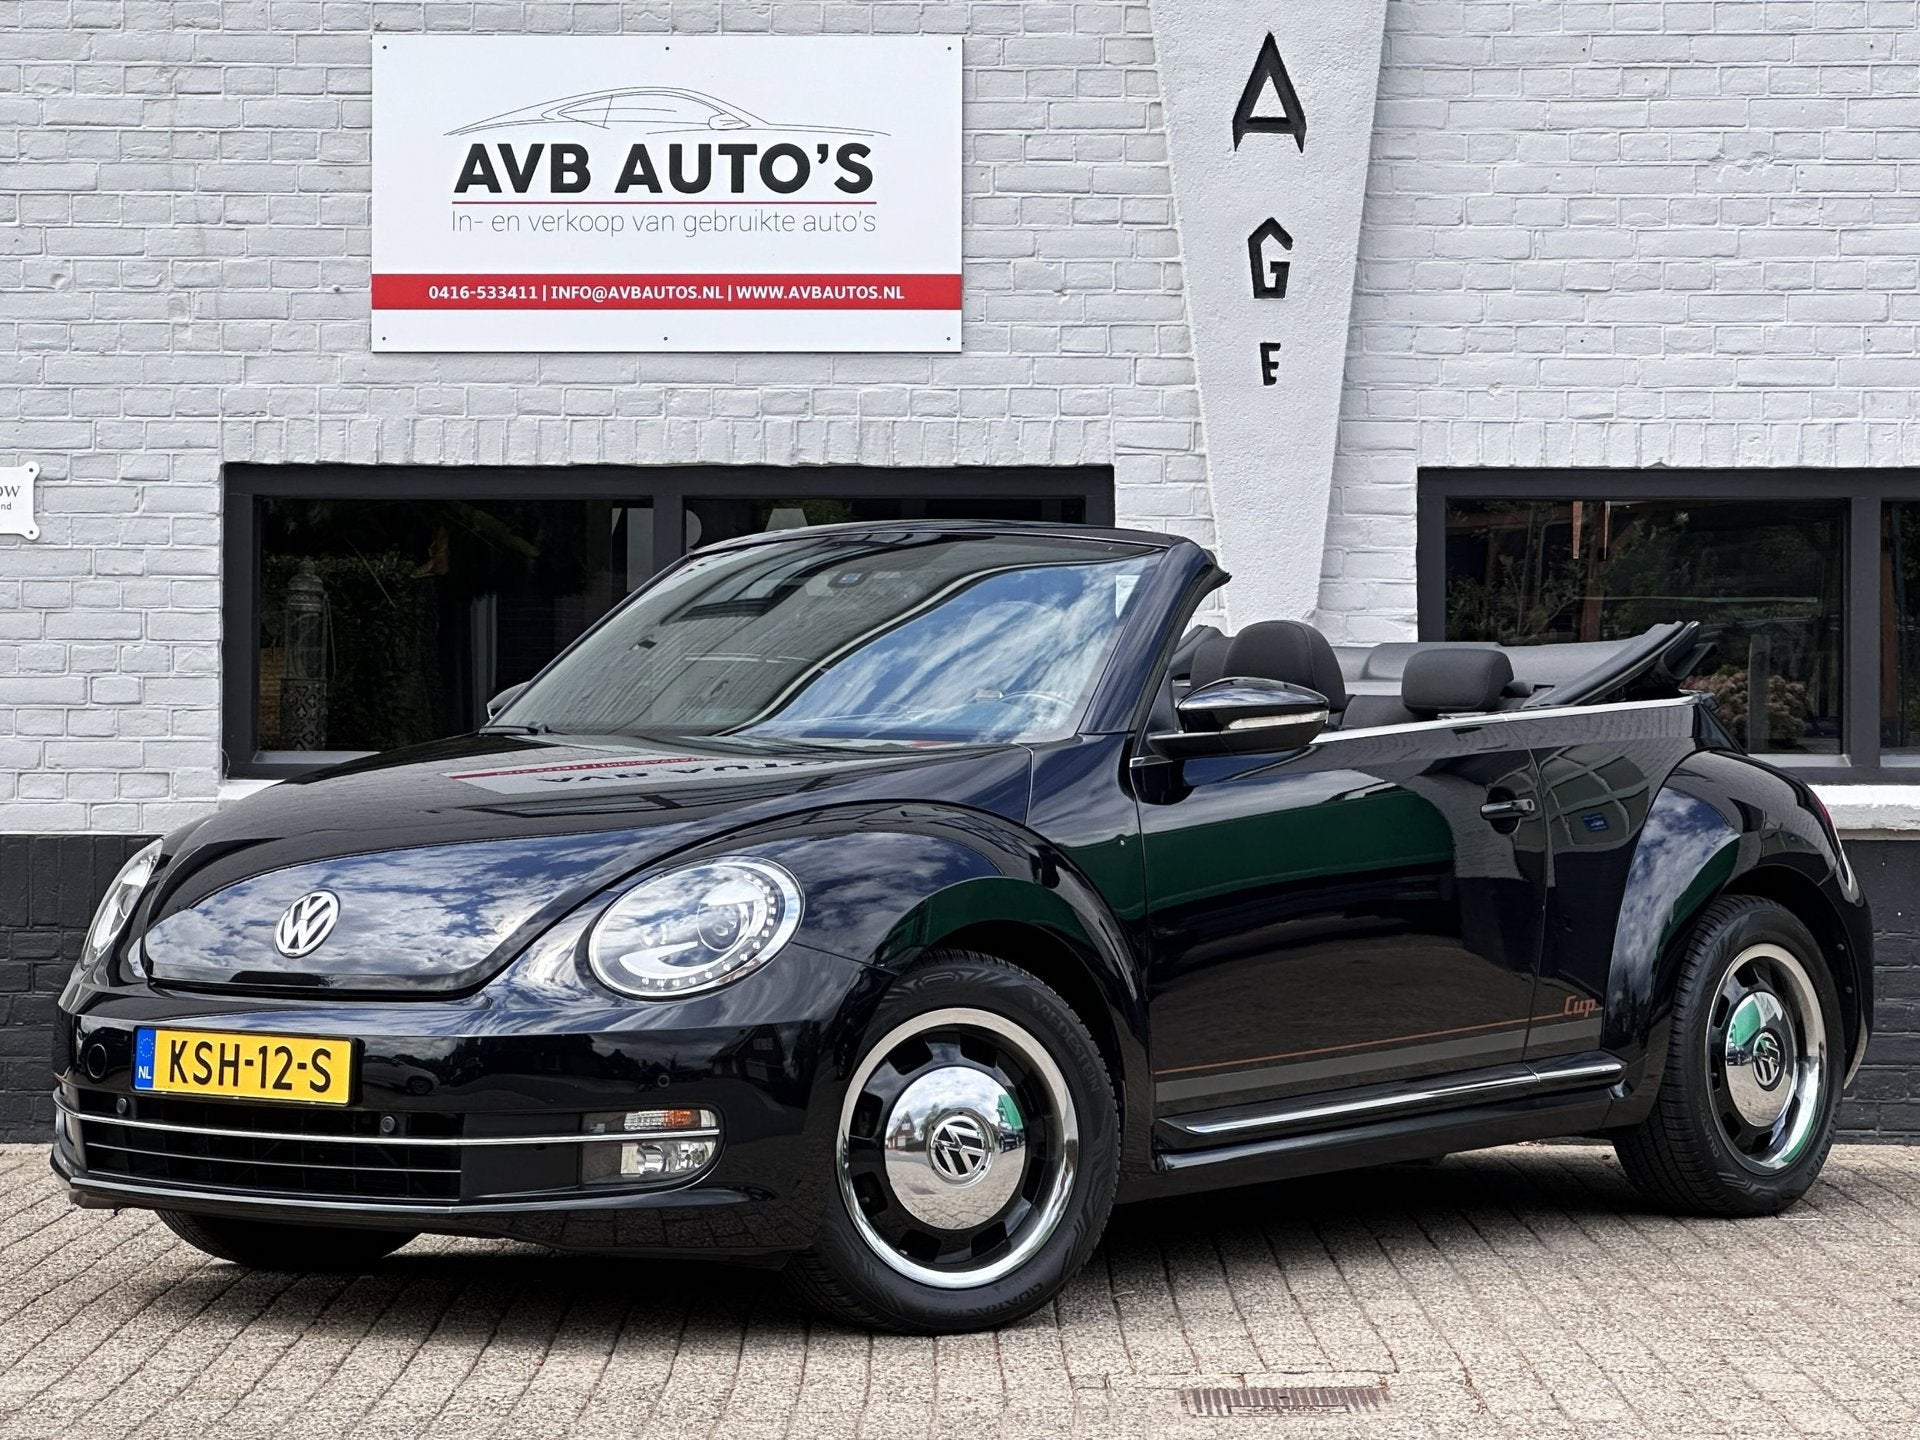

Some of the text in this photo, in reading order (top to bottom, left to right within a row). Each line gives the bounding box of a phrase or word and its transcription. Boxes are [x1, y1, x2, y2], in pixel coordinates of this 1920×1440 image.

[453, 142, 873, 194] AVB AUTO'S
[452, 208, 876, 238] In- en verkoop van gebruikte auto's
[428, 285, 905, 303] 0416-533411 INFO@AVBAUTOS.NL WWW.AVBAUTOS.NL
[1564, 995, 1597, 1018] Cup
[137, 1065, 152, 1080] NL
[169, 1039, 332, 1093] KSH-12-S
